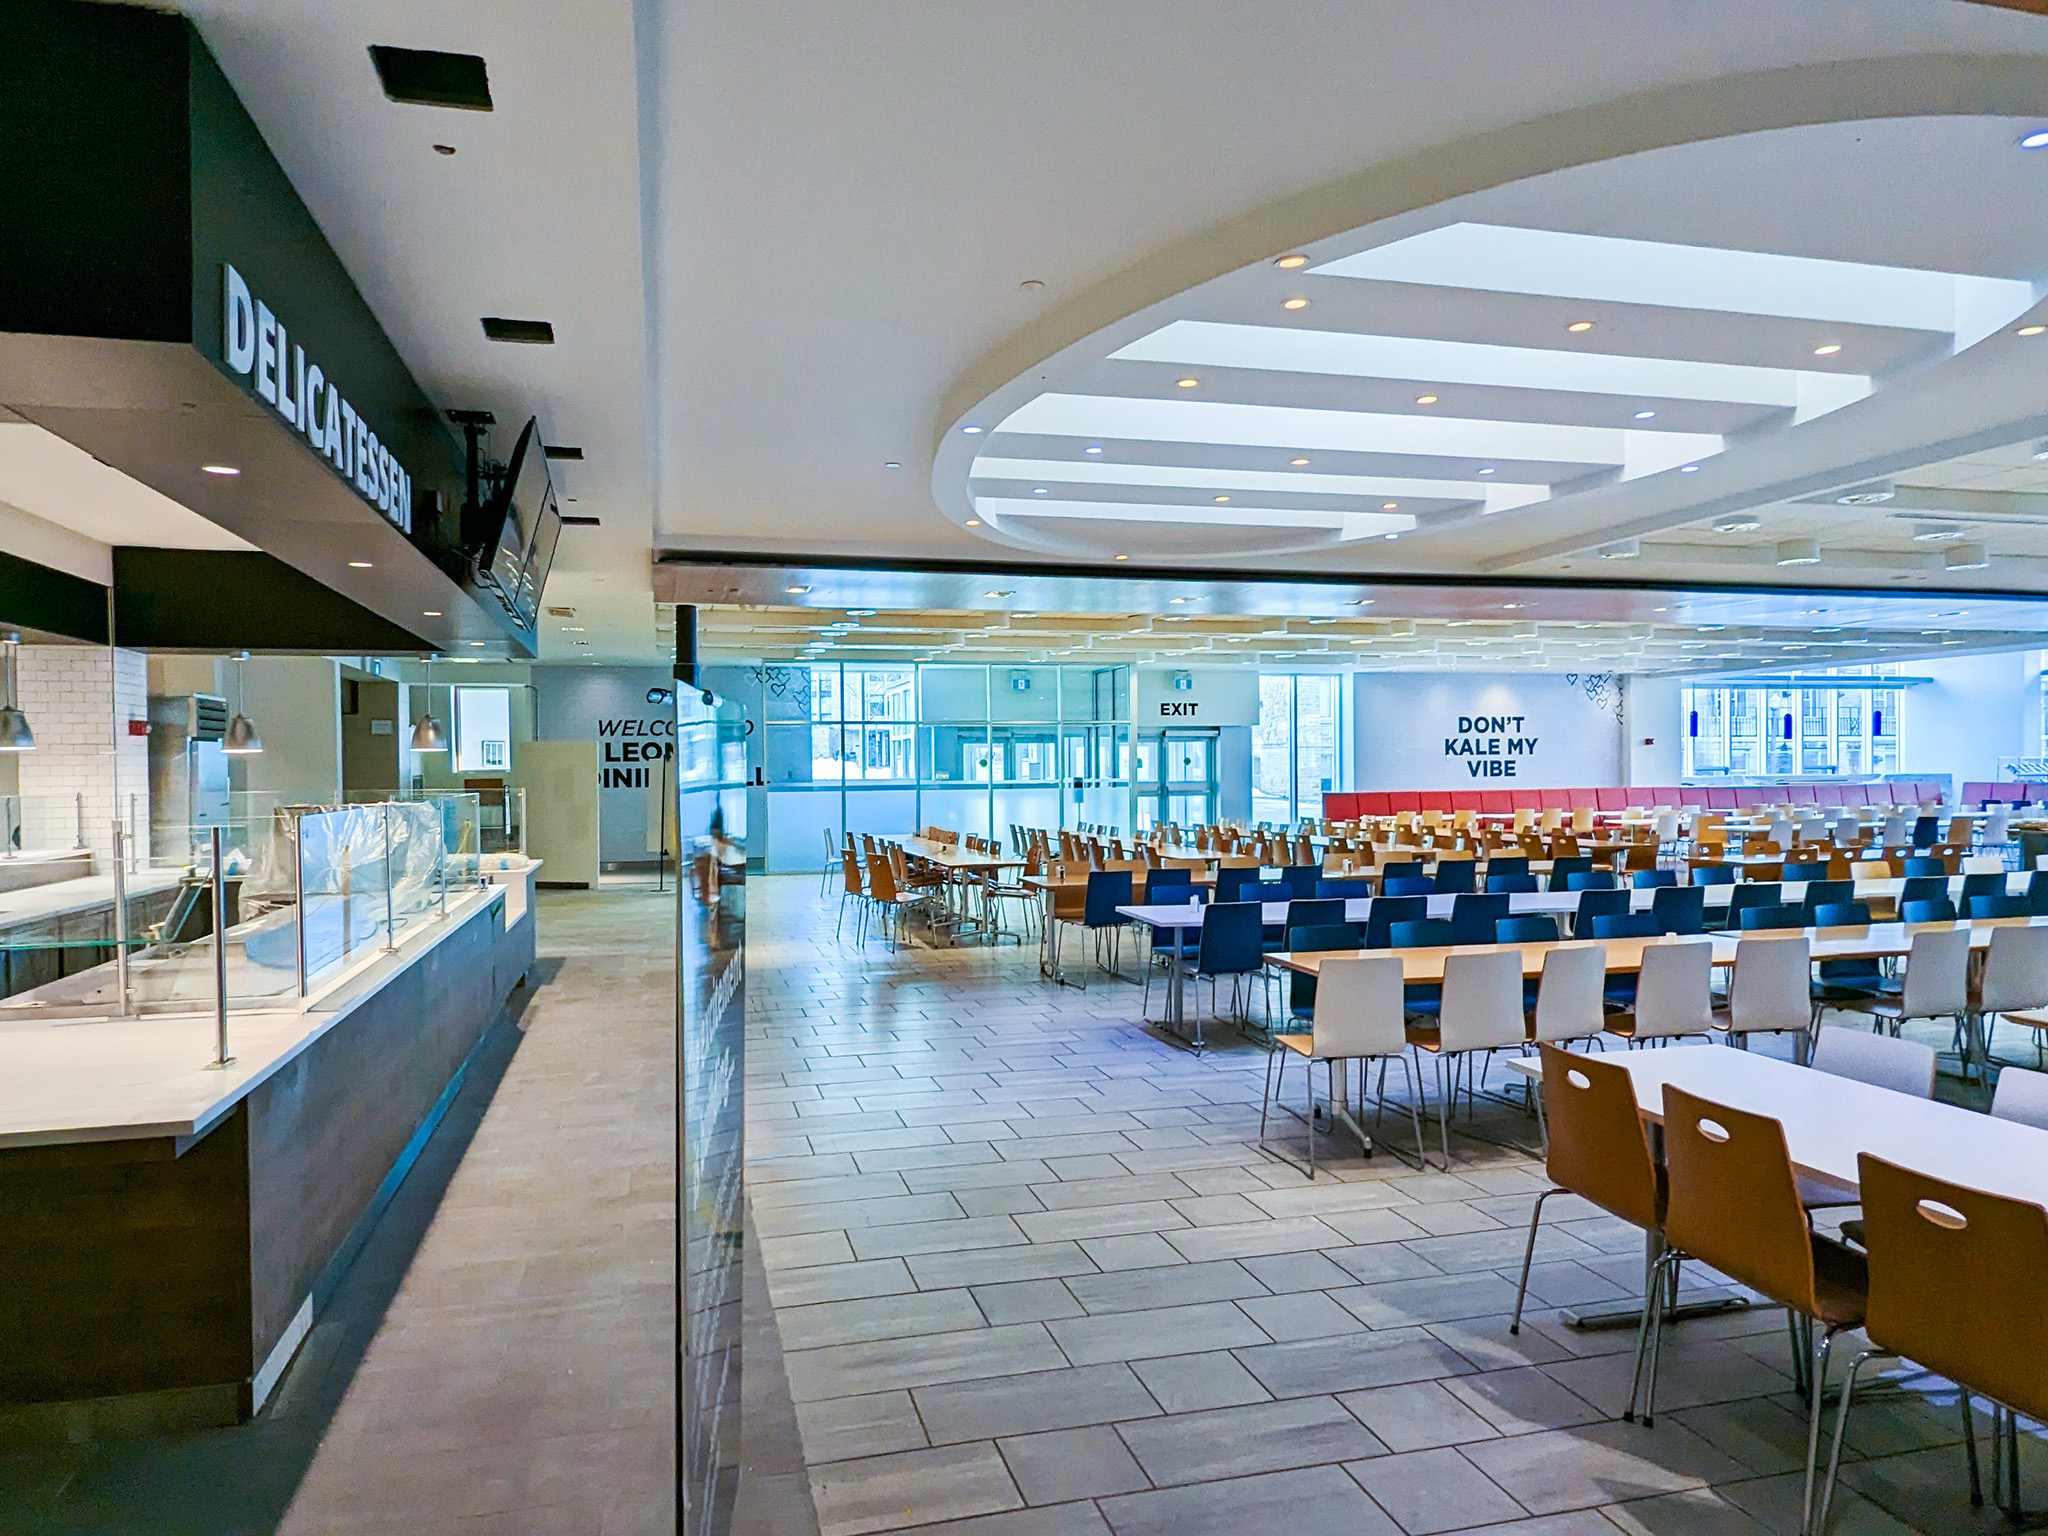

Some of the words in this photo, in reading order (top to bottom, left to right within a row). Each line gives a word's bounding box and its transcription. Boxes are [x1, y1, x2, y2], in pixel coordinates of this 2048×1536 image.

[224, 264, 411, 534] DELICATESSEN
[1160, 703, 1198, 716] EXIT
[1458, 716, 1524, 733] DON'T
[1445, 738, 1500, 756] KALE
[1507, 738, 1538, 755] MY
[1467, 760, 1516, 777] VIBE
